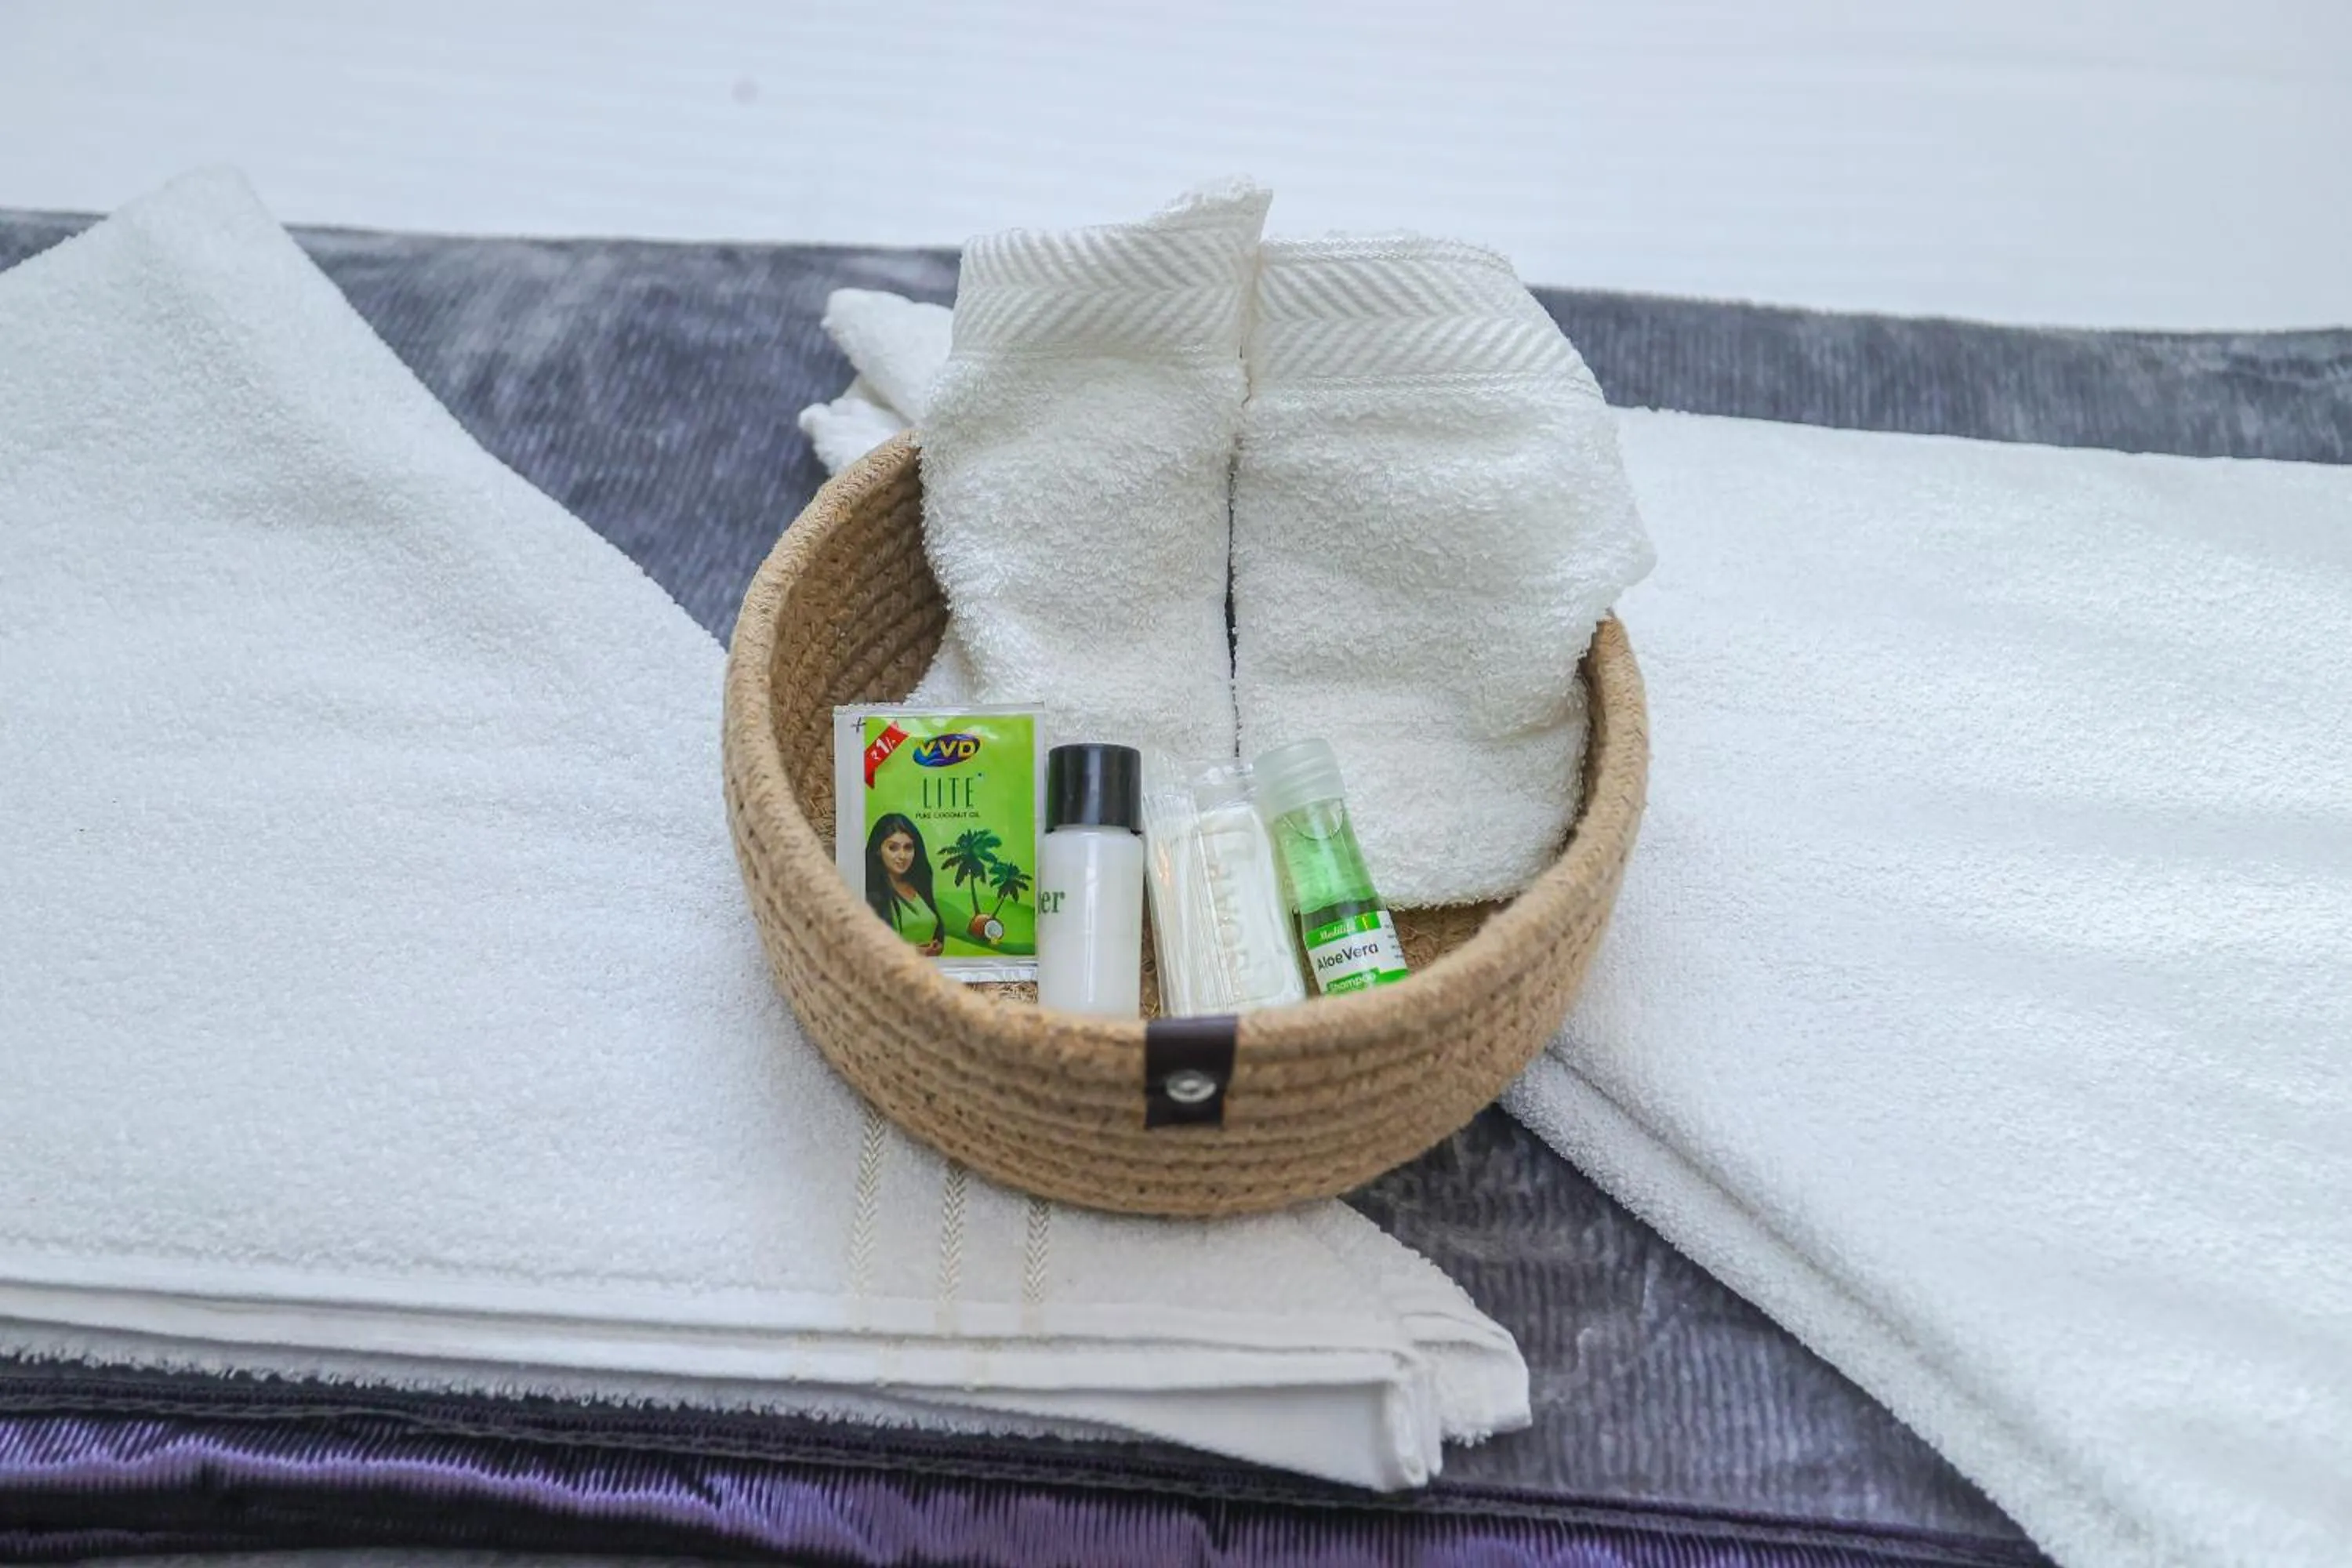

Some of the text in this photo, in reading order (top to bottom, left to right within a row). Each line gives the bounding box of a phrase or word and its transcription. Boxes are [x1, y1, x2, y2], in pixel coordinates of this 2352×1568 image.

[919, 739, 976, 758] VVD
[923, 777, 974, 809] LITE
[1037, 891, 1065, 914] er
